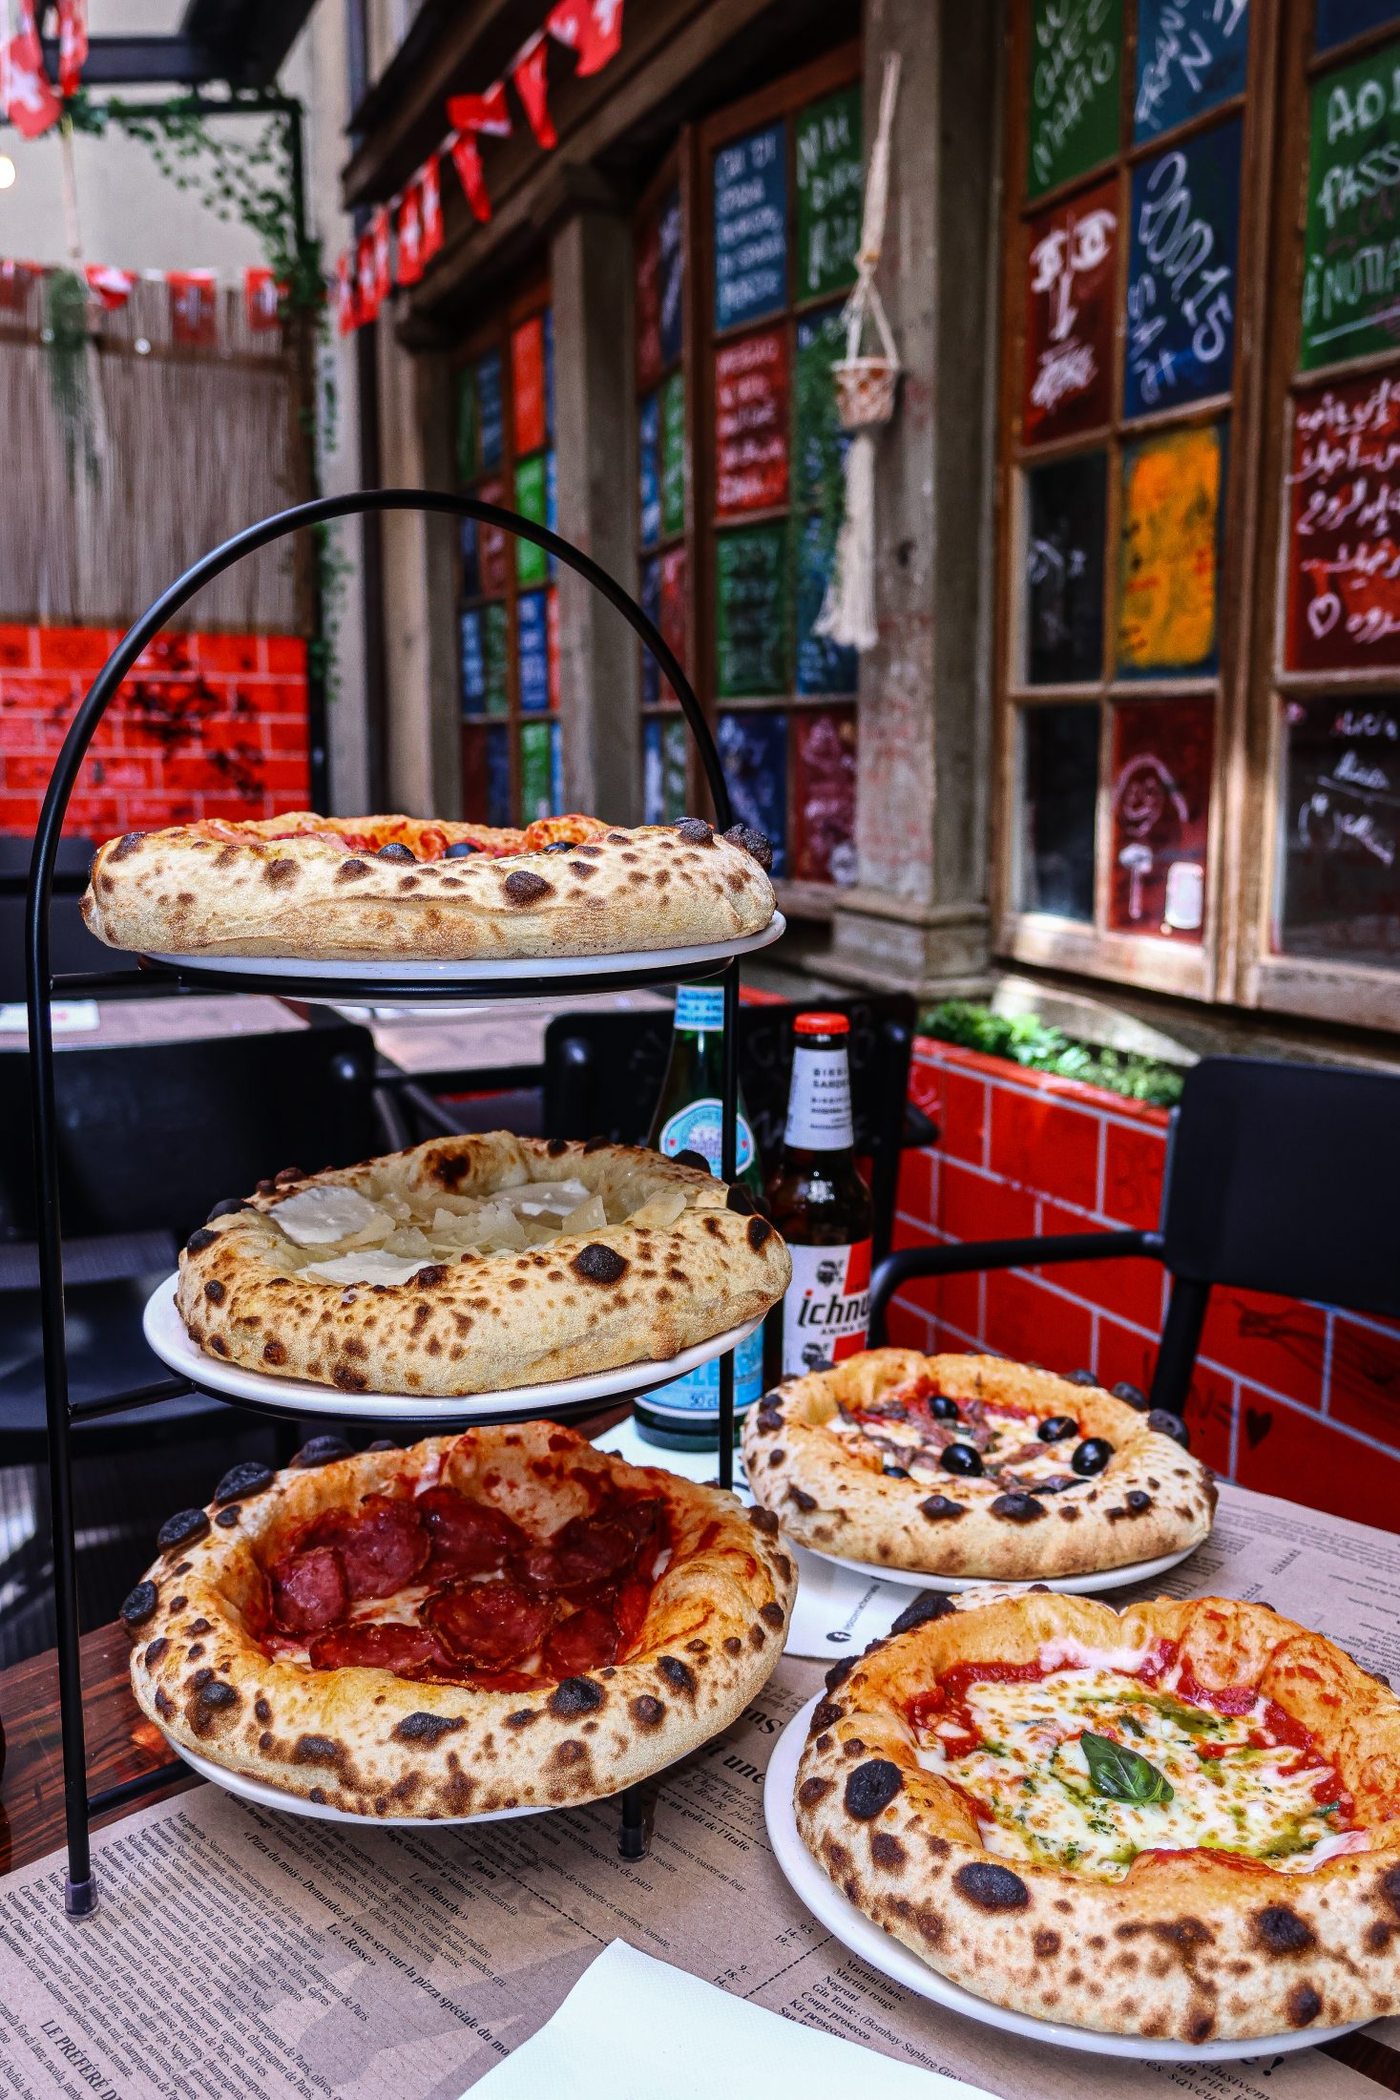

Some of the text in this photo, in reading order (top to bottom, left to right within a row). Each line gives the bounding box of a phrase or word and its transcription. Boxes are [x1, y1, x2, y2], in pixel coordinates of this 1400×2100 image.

[669, 1801, 684, 1810] un
[679, 1808, 706, 1823] goût
[702, 1819, 718, 1831] de
[265, 1850, 281, 1862] du
[470, 1859, 497, 1880] Pasta
[558, 1829, 653, 1891] accompagnées de pain
[652, 1856, 677, 1873] toaster
[668, 1841, 696, 1859] maison
[693, 1856, 720, 1875] toaster
[717, 1872, 730, 1881] au
[727, 1877, 746, 1892] four
[407, 1872, 424, 1885] Le
[301, 1879, 346, 1917] Demandez
[325, 1923, 341, 1936] Le
[342, 1914, 356, 1923] à
[348, 1921, 375, 1941] votre
[420, 1902, 492, 1958] copeaux grana padano
[386, 1892, 416, 1914] copeaux
[412, 1911, 425, 1920] di
[419, 1918, 443, 1936] Grana
[464, 1955, 495, 1977] jambon
[491, 1976, 507, 1987] cru
[370, 1940, 408, 1969] serveur
[226, 1951, 271, 1990] salami piquant
[403, 1966, 417, 1977] la
[842, 1959, 883, 1985] Martini
[877, 1981, 906, 2001] blanc
[88, 1983, 102, 1997] fior
[98, 1994, 111, 2004] di
[216, 1963, 273, 2013] salami tipo Napoli
[276, 1978, 303, 2001] oignons
[302, 1963, 368, 2021] champignon de Paris
[306, 1986, 330, 2006] câpres
[410, 1976, 442, 1998] pizza
[811, 1983, 832, 1998] Gin
[822, 1975, 862, 2001] Negroni
[832, 1967, 873, 1993] Martini
[867, 1991, 896, 2010] rouge
[31, 1943, 62, 1975] Mozzarella
[57, 1972, 71, 1986] fior
[67, 1983, 79, 1992] di
[84, 2005, 110, 2029] jambon
[119, 2041, 161, 2083] champignons
[157, 2081, 170, 2093] de
[105, 1979, 119, 1992] fior
[115, 1989, 128, 1999] di
[135, 2012, 161, 2034] salami
[154, 2032, 170, 2046] tipo
[438, 1997, 479, 2029] spéciale
[788, 1999, 847, 2039] Kir prosecco
[799, 1991, 871, 2040] Coupe prosecco
[13, 2024, 27, 2038] fior
[23, 2035, 36, 2045] di
[42, 1980, 67, 2005] salamen
[93, 2036, 113, 2055] sauce
[108, 2053, 132, 2077] tomate
[475, 2026, 494, 2042] du
[39, 2020, 62, 2039] LE
[53, 2035, 111, 2091] PRÉFÉRÉ
[132, 1987, 159, 2012] saucisse
[201, 2058, 245, 2100] champignons
[0, 2058, 10, 2069] di
[1198, 2076, 1231, 2095] rite
